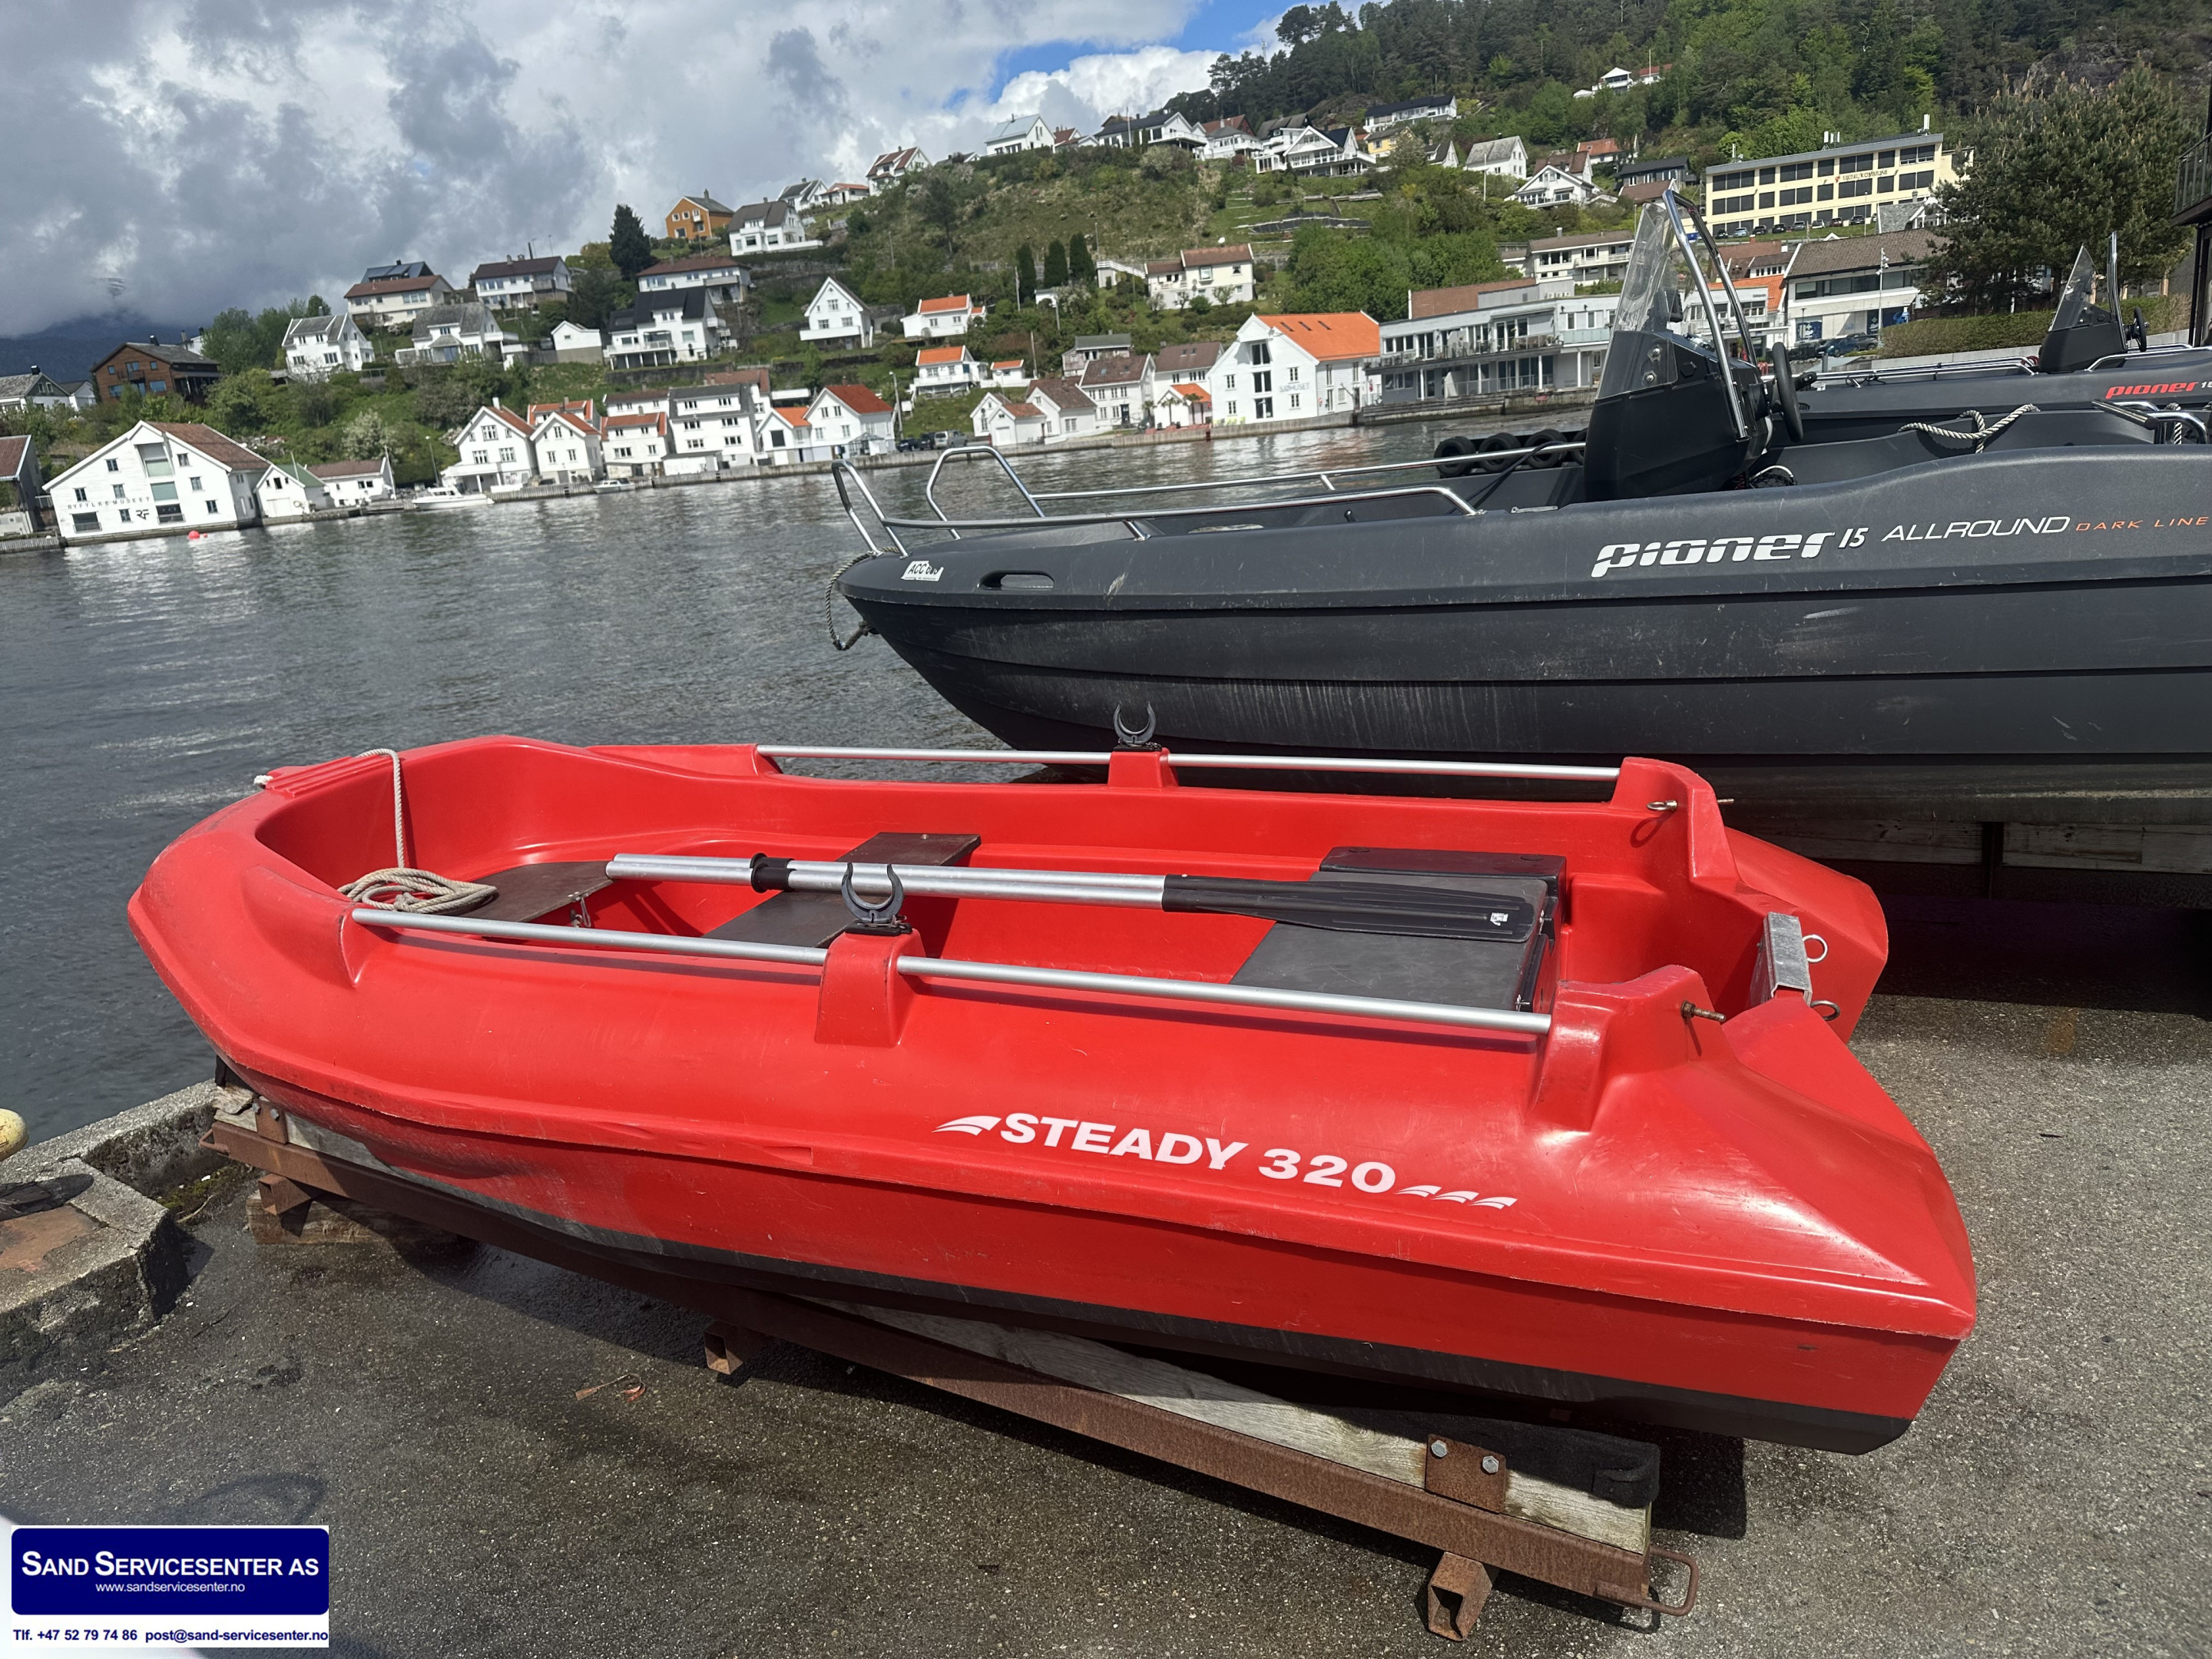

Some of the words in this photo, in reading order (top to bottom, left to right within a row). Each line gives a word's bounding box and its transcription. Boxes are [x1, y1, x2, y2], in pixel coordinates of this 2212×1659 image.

[2105, 382, 2199, 399] pioner
[1591, 531, 1835, 578] pioner
[1838, 527, 1869, 548] 15
[1881, 516, 2071, 542] ALLROUND
[2075, 519, 2144, 531] DARK
[2154, 516, 2210, 528] LINE
[1000, 1112, 1250, 1171] STEADY
[1258, 1148, 1396, 1194] 320
